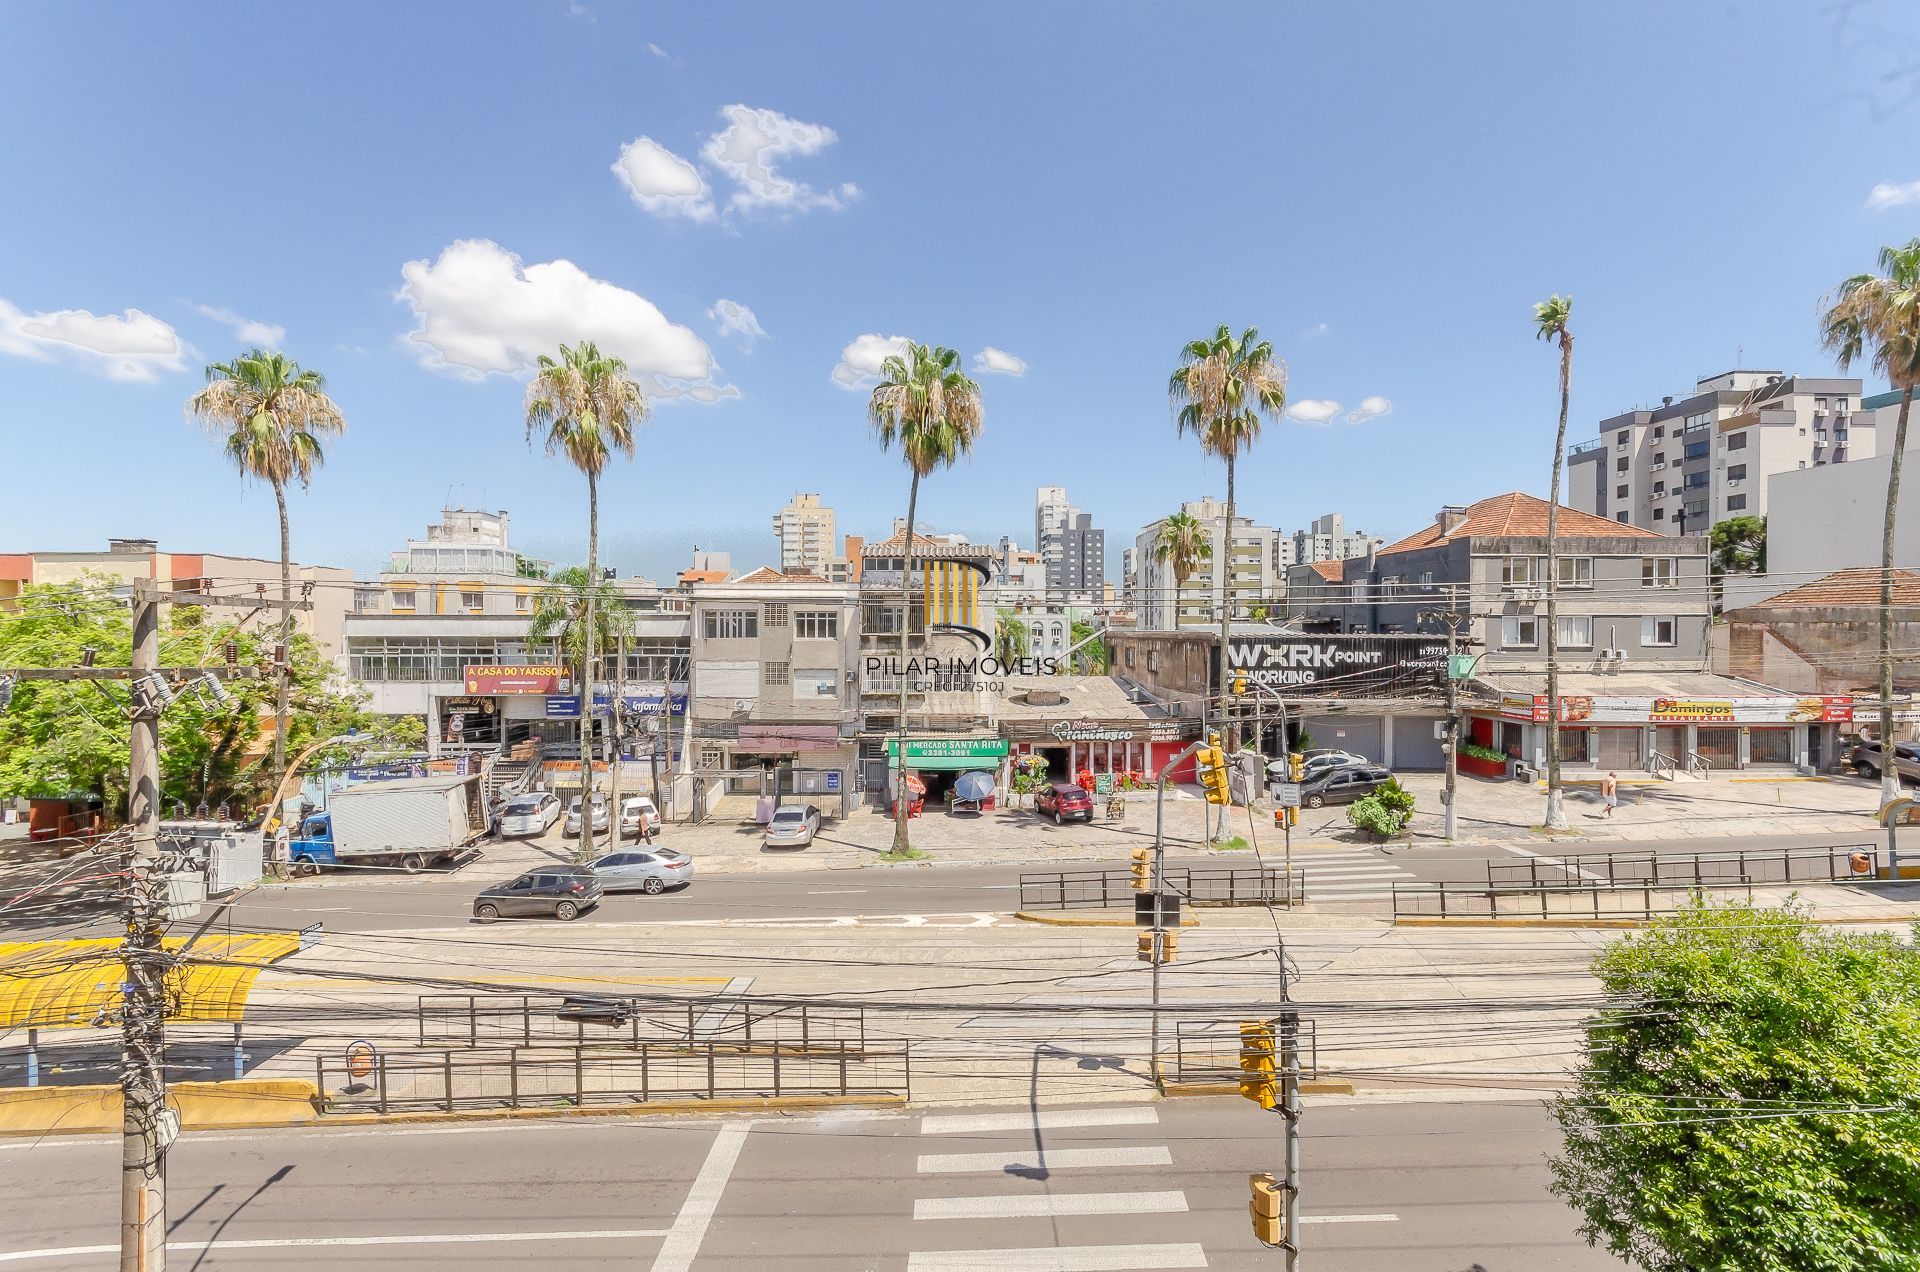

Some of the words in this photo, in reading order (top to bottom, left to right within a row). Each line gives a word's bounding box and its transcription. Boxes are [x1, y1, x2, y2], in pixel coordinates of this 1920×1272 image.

[1335, 651, 1382, 663] POINT
[468, 667, 476, 676] A
[477, 667, 503, 676] CASA
[504, 667, 518, 676] DO
[1653, 700, 1731, 715] Domingos
[912, 741, 947, 749] MERCADO
[948, 740, 980, 749] SANTA
[981, 740, 1003, 749] RITA
